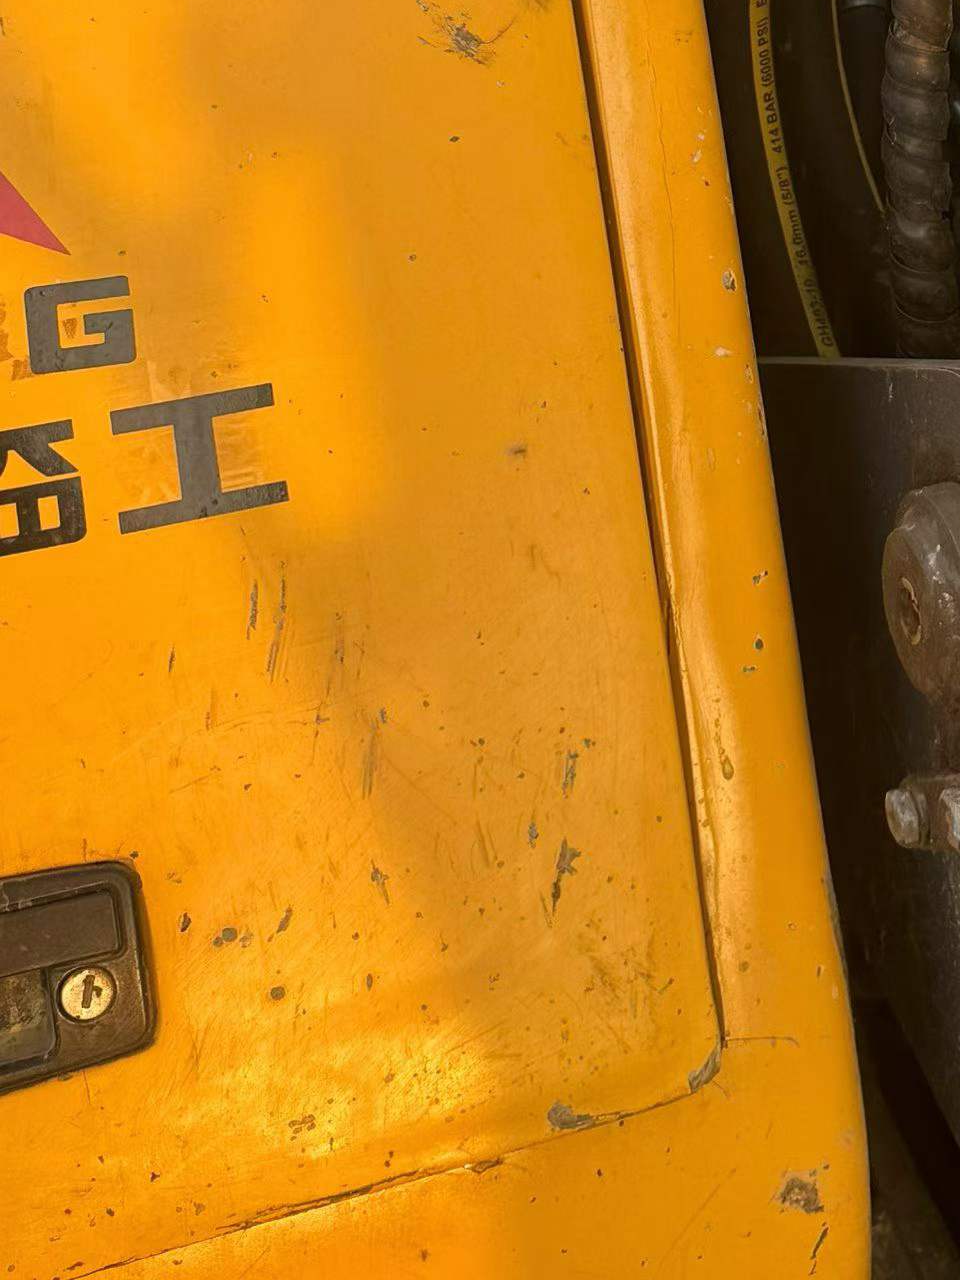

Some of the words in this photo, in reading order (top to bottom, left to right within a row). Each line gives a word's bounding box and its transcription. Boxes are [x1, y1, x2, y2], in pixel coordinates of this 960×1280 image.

[759, 50, 774, 87] (6000
[763, 90, 778, 124] BAR
[768, 127, 783, 153] 414
